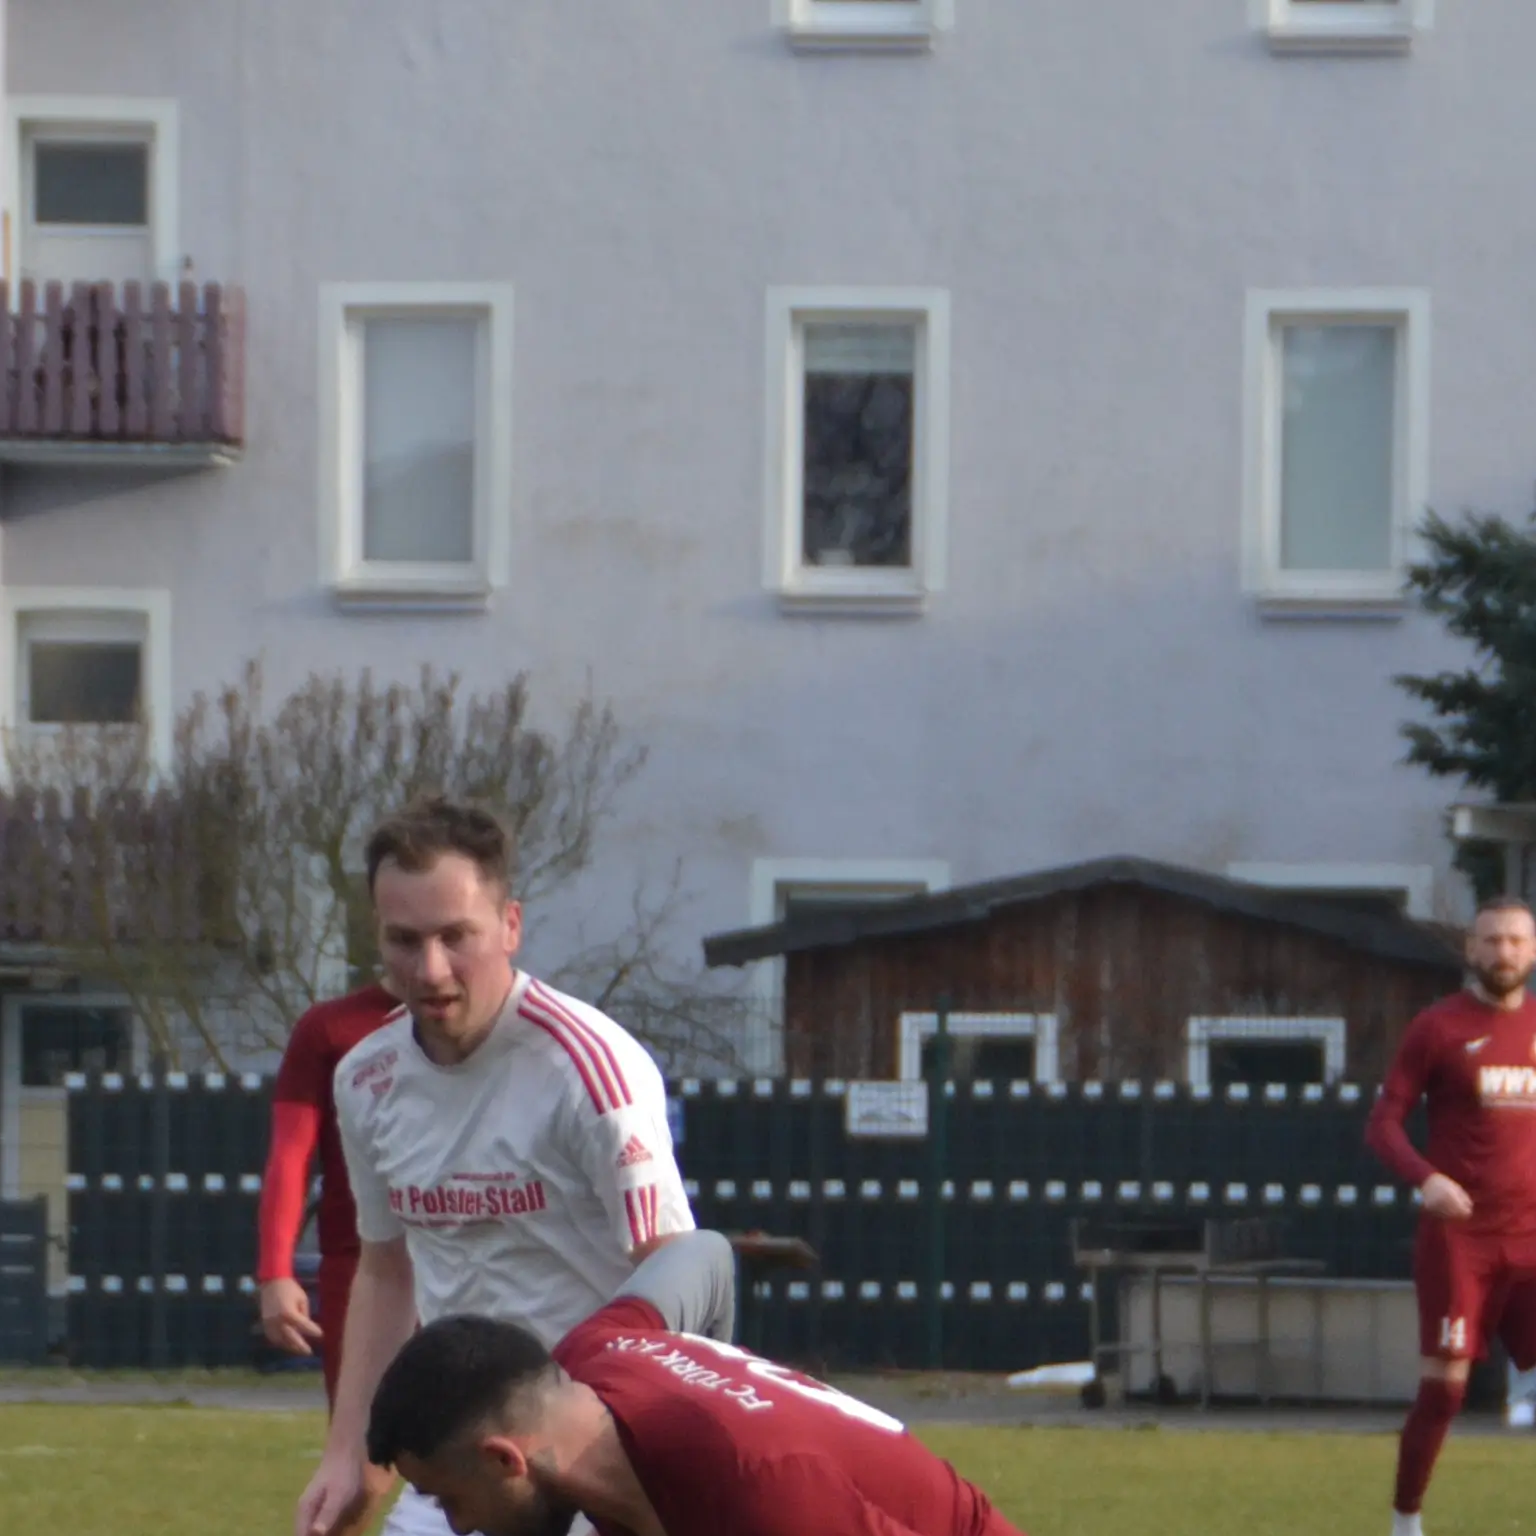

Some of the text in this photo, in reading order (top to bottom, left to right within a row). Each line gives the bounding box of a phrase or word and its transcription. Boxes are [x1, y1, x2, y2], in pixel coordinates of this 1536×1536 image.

[408, 1180, 547, 1216] Polster-Stall
[1441, 1316, 1465, 1349] 14
[724, 1384, 774, 1410] FC
